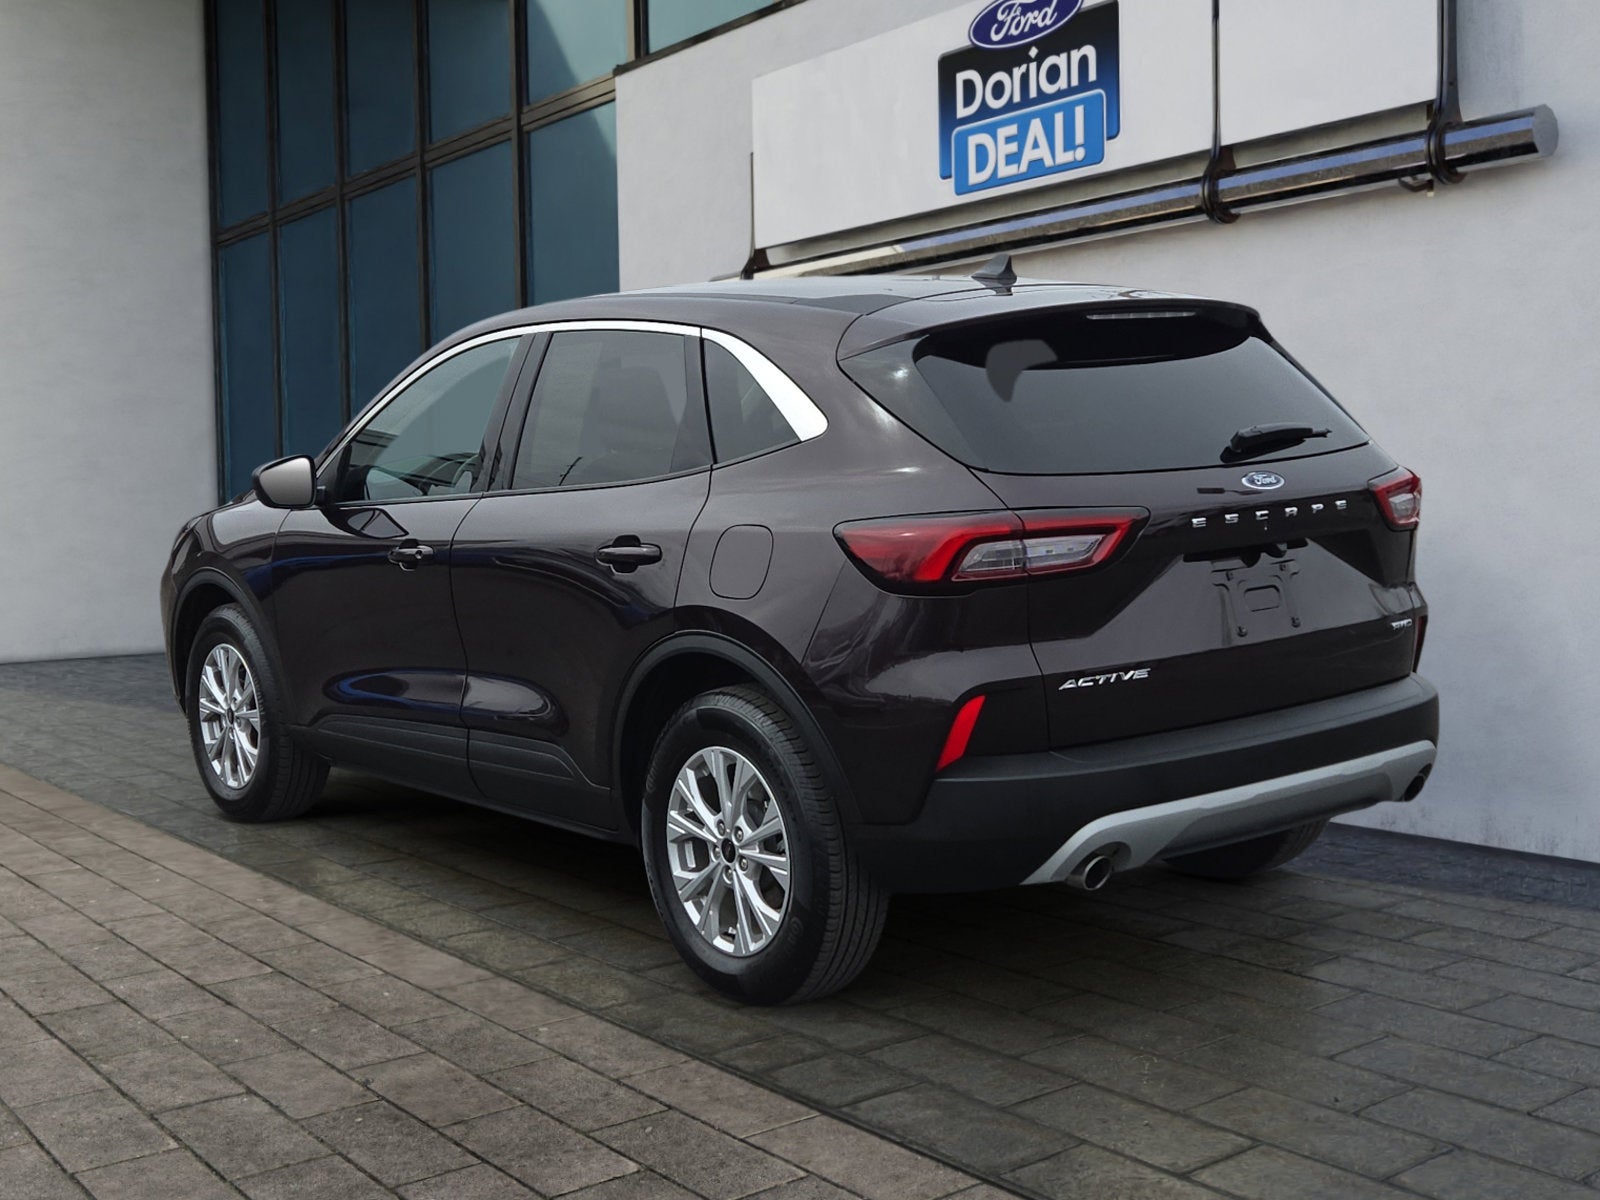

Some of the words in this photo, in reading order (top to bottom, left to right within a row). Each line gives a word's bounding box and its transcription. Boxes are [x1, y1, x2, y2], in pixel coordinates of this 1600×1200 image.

[990, 0, 1058, 41] Ford
[955, 45, 1097, 119] Dorian
[967, 105, 1086, 186] DEAL!
[1191, 499, 1347, 528] ESCAPE
[1058, 668, 1151, 690] ACTIVE
